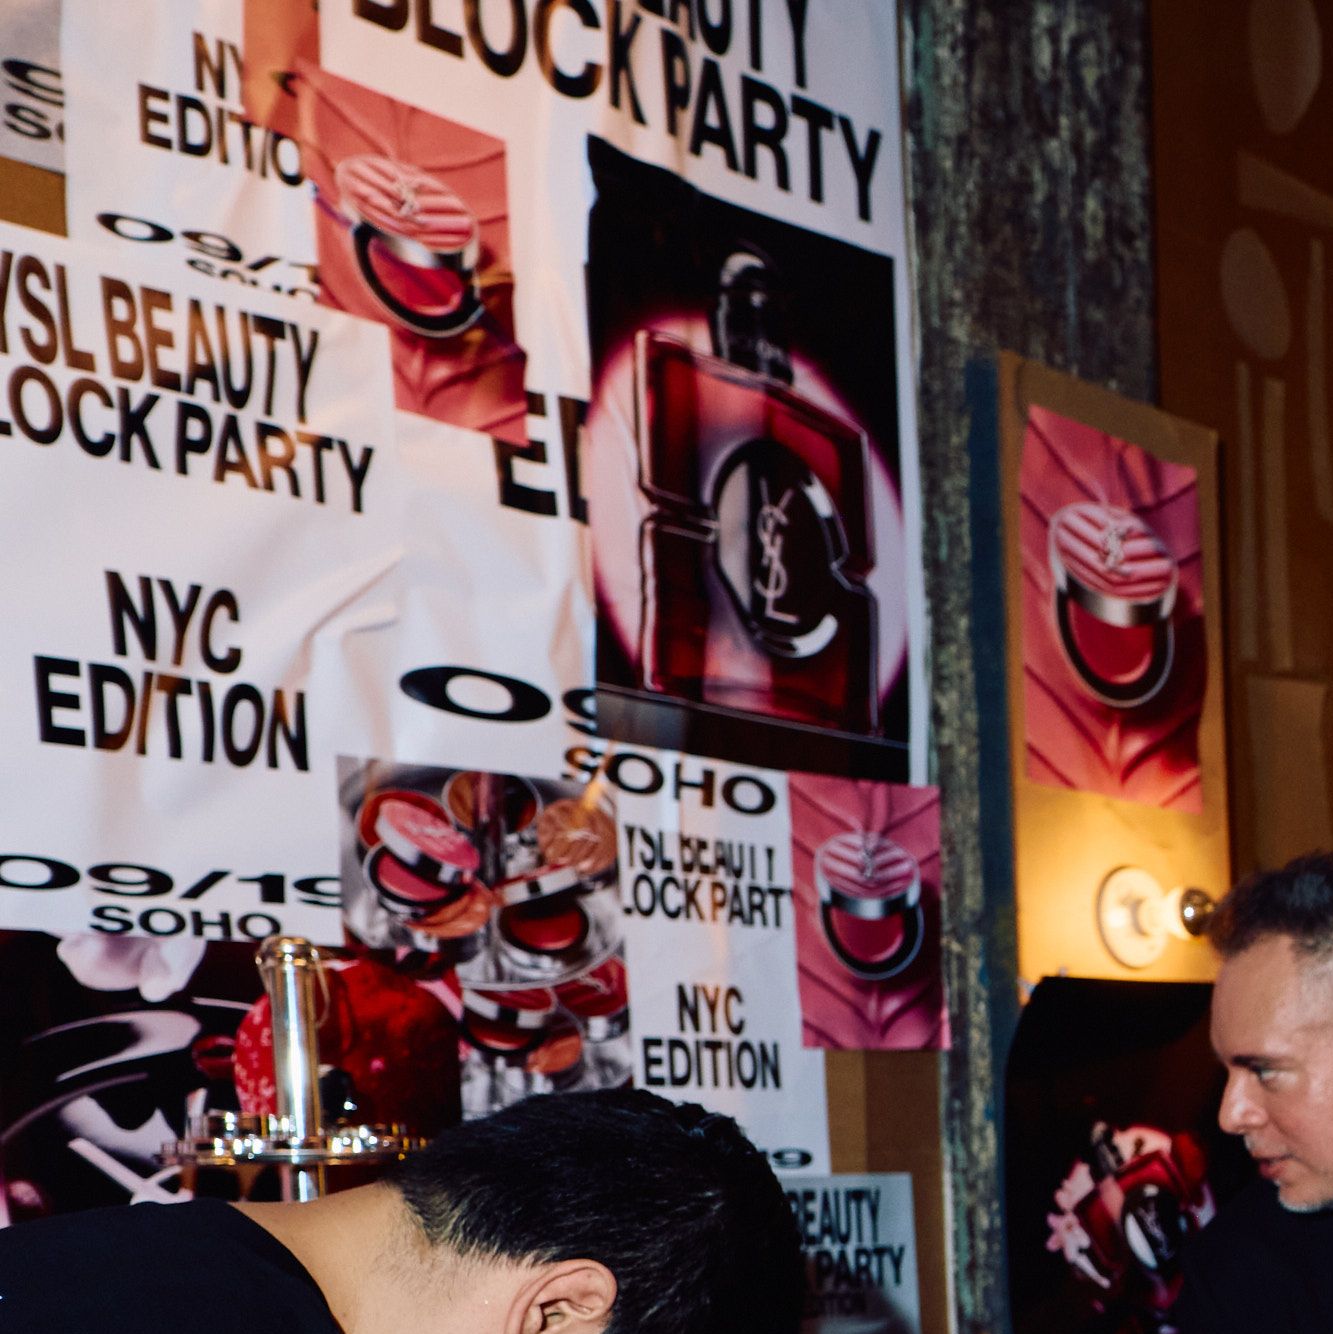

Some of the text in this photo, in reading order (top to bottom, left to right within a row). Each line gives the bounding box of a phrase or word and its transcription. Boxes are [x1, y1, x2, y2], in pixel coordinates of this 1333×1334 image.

[137, 81, 306, 187] EDITIO
[351, 0, 882, 223] LOCK PARTY
[100, 272, 320, 425] BEAUTY
[0, 364, 162, 471] OCK
[175, 399, 375, 514] PARTY
[104, 569, 243, 675] NYC
[33, 654, 310, 772] EDITION
[90, 904, 282, 941] SOHO
[624, 874, 792, 928] OCK PART
[676, 982, 745, 1036] NYC
[642, 1037, 782, 1090] EDITION
